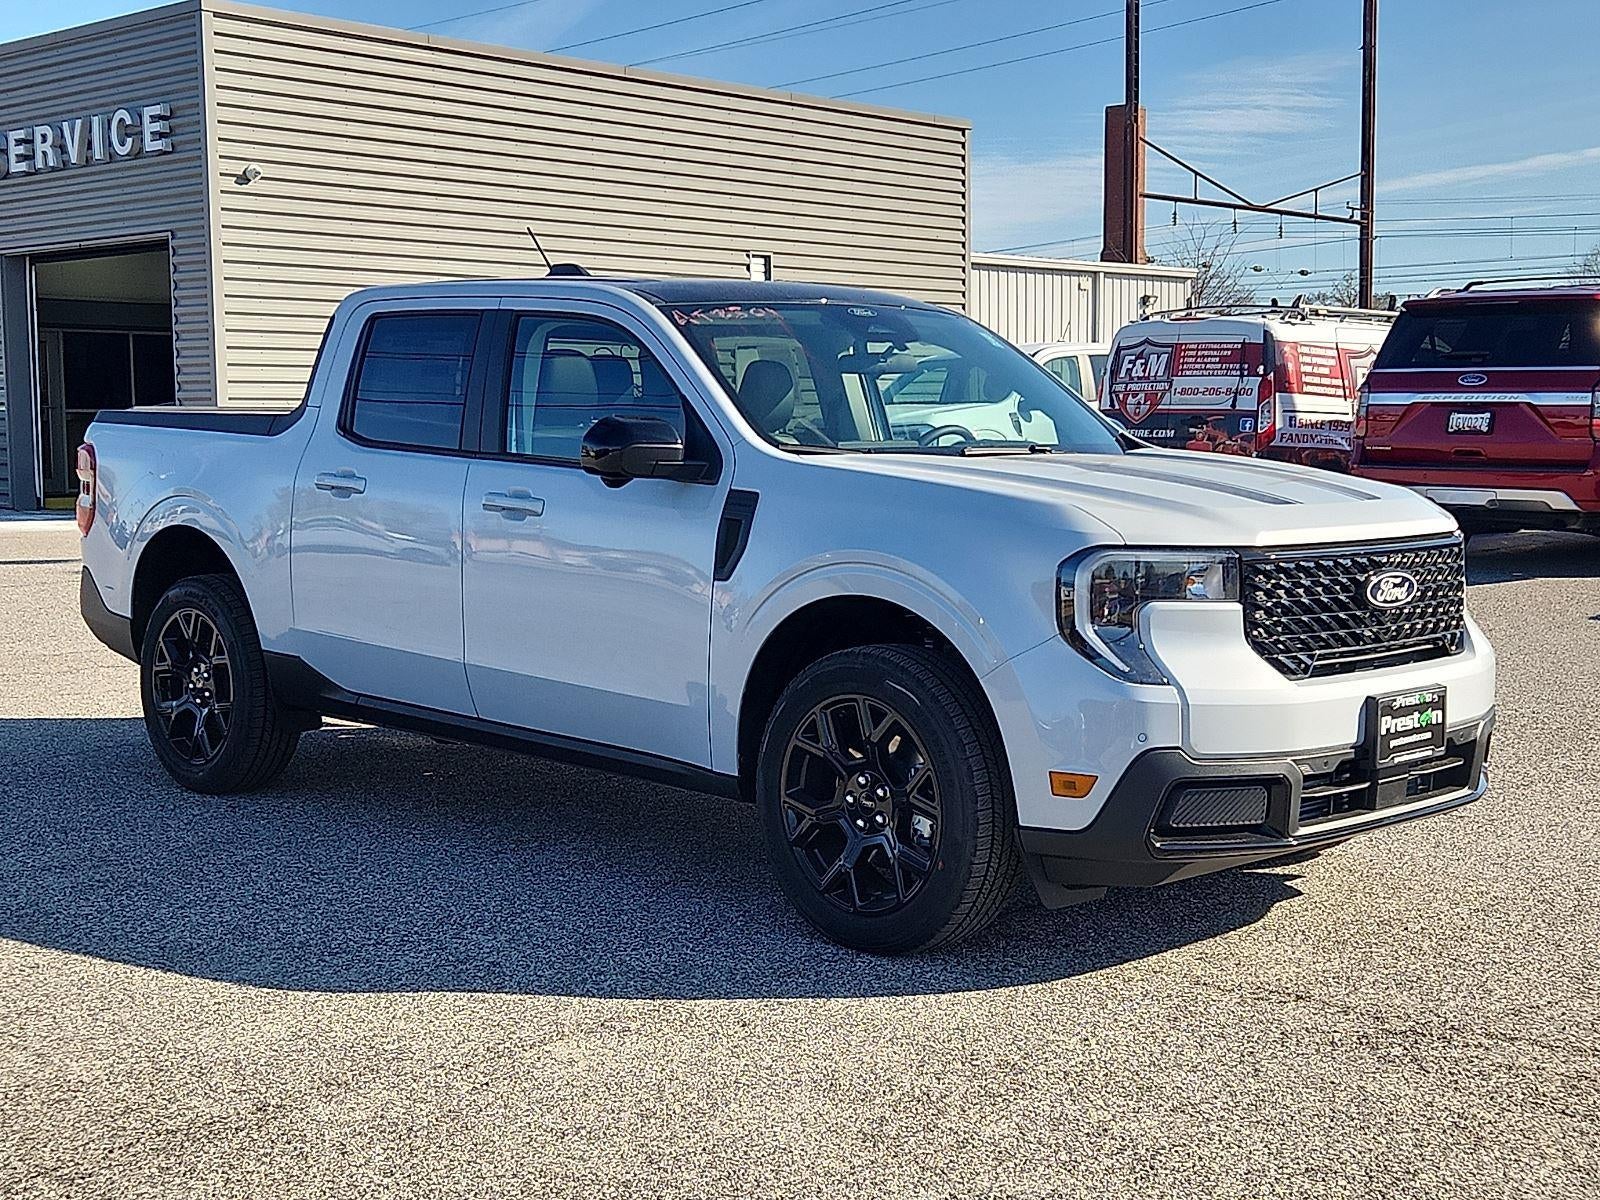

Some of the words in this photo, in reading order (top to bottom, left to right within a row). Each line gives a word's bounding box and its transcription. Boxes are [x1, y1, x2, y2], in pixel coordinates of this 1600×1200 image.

[0, 103, 172, 178] ERVICE
[1119, 353, 1169, 378] F&M
[1112, 384, 1126, 392] FIRE
[1127, 382, 1170, 391] PROTECTION
[1297, 418, 1326, 430] SINCE
[1327, 420, 1351, 432] 1959
[1374, 575, 1412, 603] Ford
[1380, 707, 1443, 736] Preston
